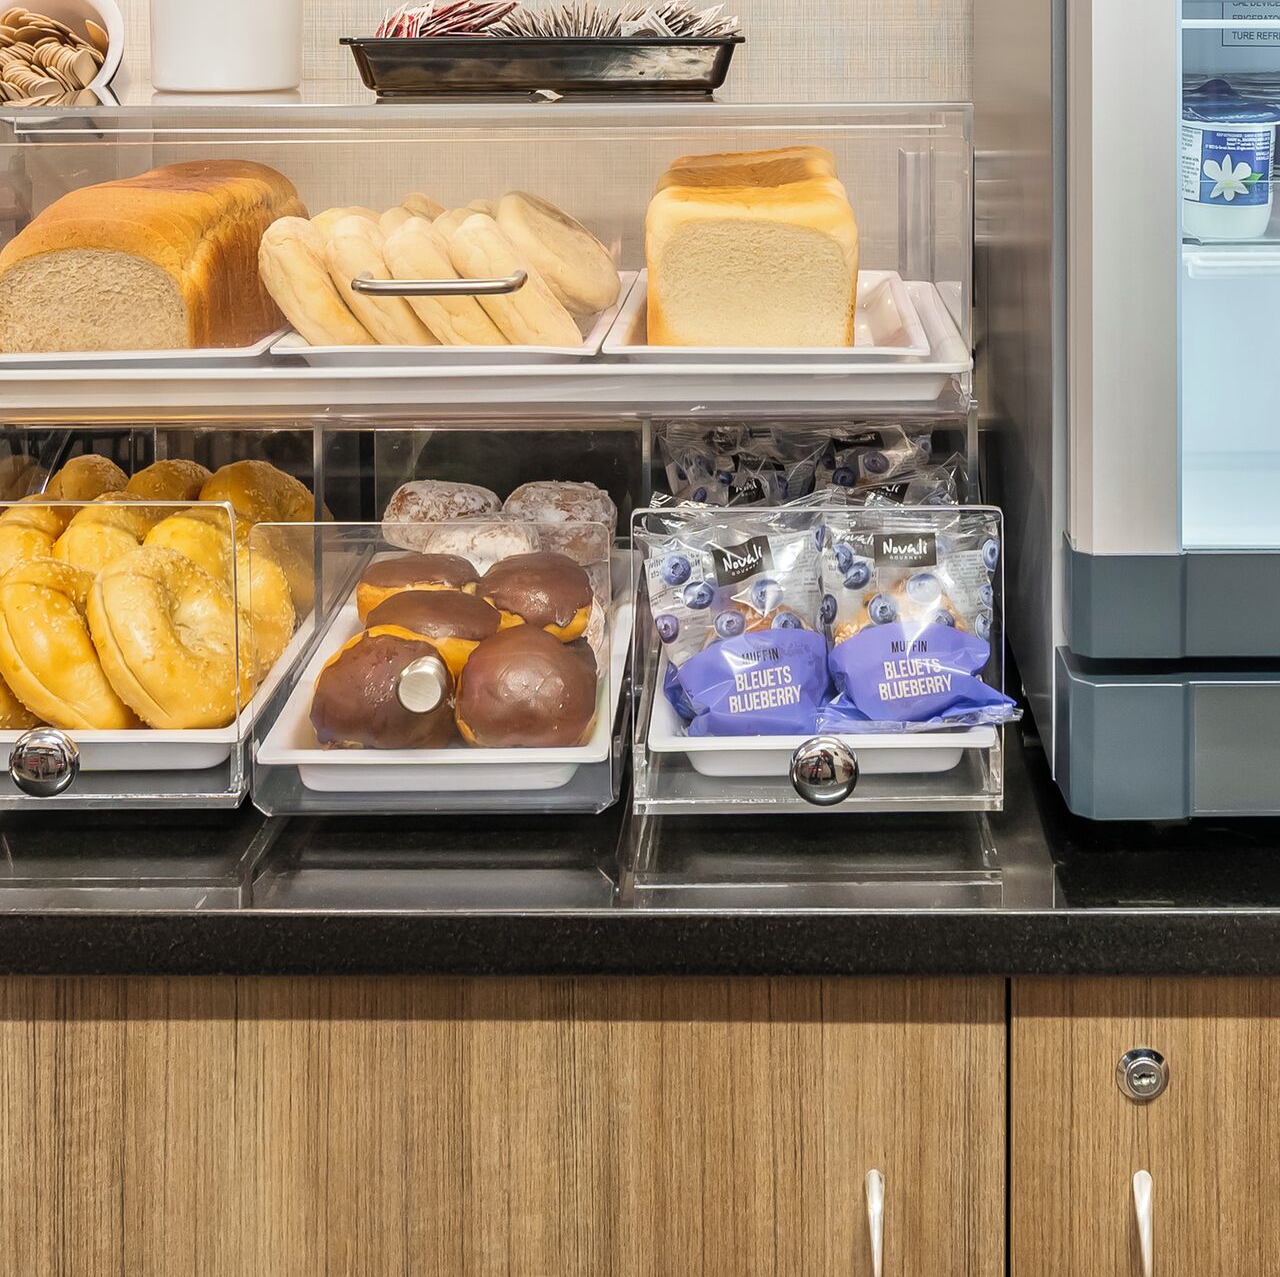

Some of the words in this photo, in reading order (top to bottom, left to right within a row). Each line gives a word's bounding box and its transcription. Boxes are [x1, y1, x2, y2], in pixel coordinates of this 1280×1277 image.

[1232, 31, 1255, 40] TURE
[722, 543, 763, 572] Novali
[883, 537, 929, 555] Novali
[734, 665, 793, 693] BLEUETS
[883, 657, 942, 681] BLEUETS
[728, 684, 802, 714] BLUEBERRY
[878, 673, 953, 702] BLUEBERRY
